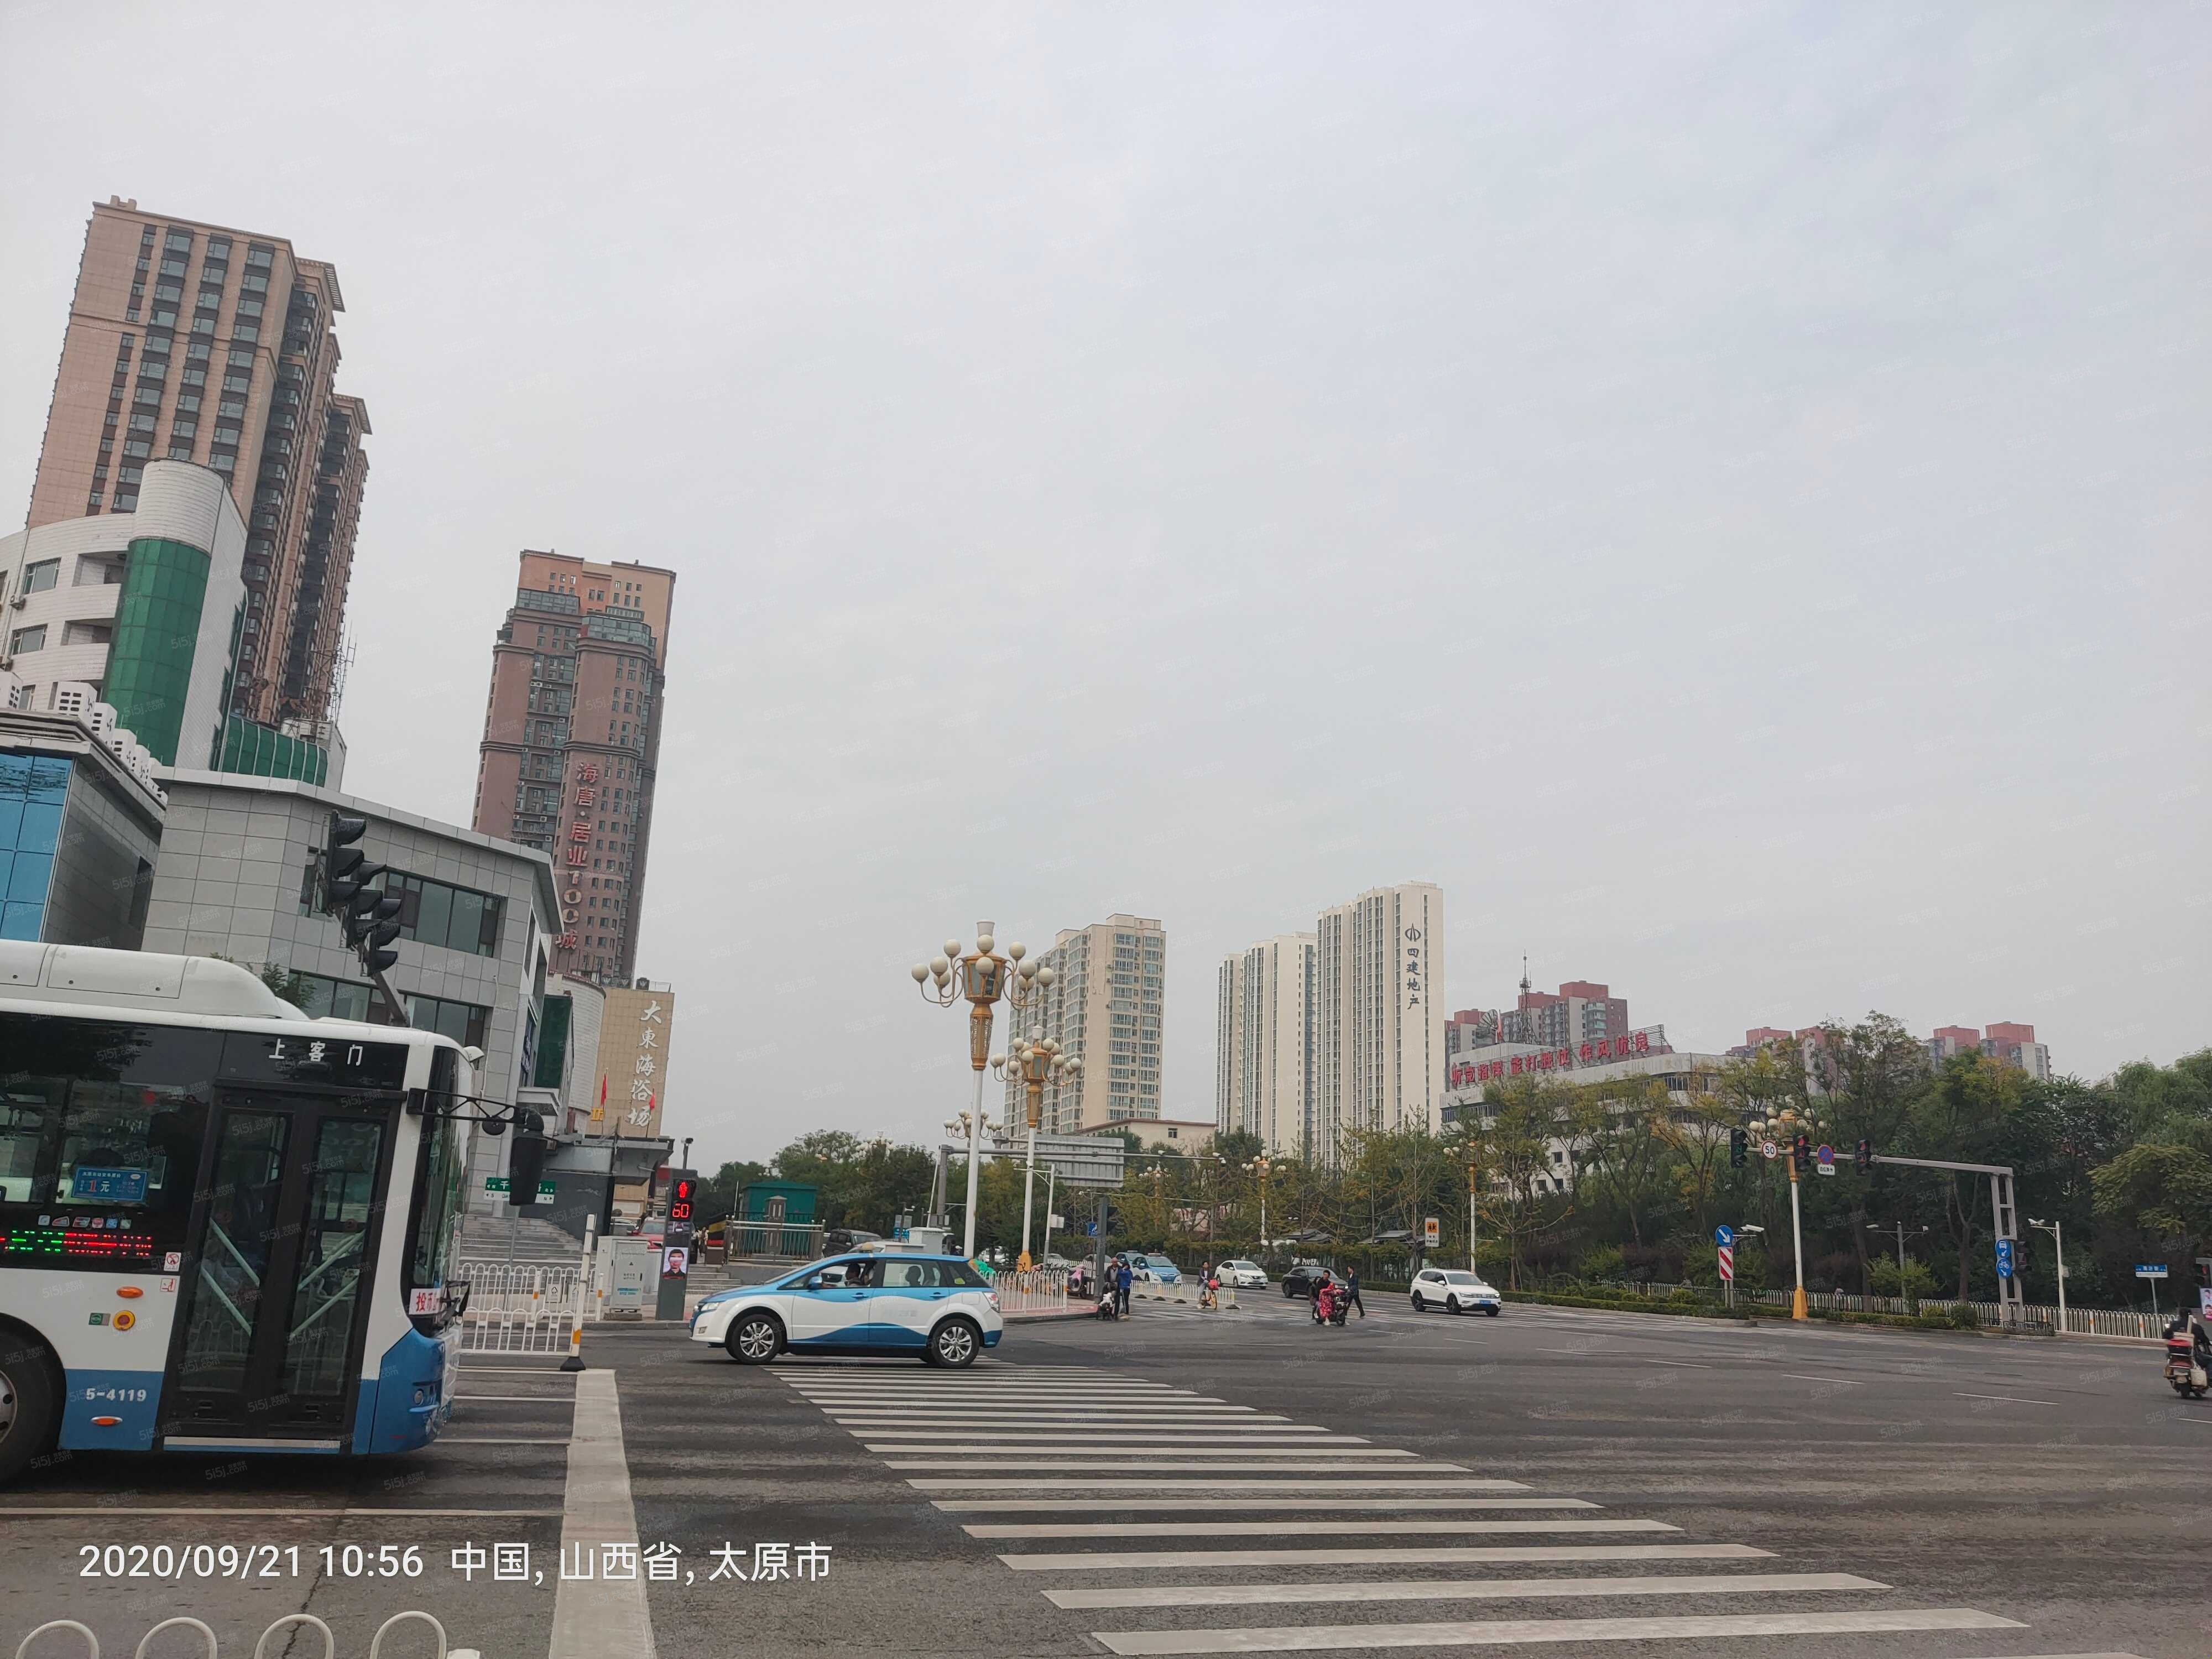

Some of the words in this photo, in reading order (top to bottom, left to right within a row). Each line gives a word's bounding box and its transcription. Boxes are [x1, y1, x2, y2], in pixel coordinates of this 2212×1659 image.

[1406, 947, 1421, 1010] 四建地产
[269, 1039, 363, 1066] 上客门
[1510, 1047, 1570, 1075] 能打胜仗
[1579, 1031, 1650, 1062] 作风优良
[1765, 1146, 1775, 1155] 50
[100, 1181, 111, 1192] 元
[672, 1203, 689, 1218] 60
[86, 1387, 147, 1402] 5-4119
